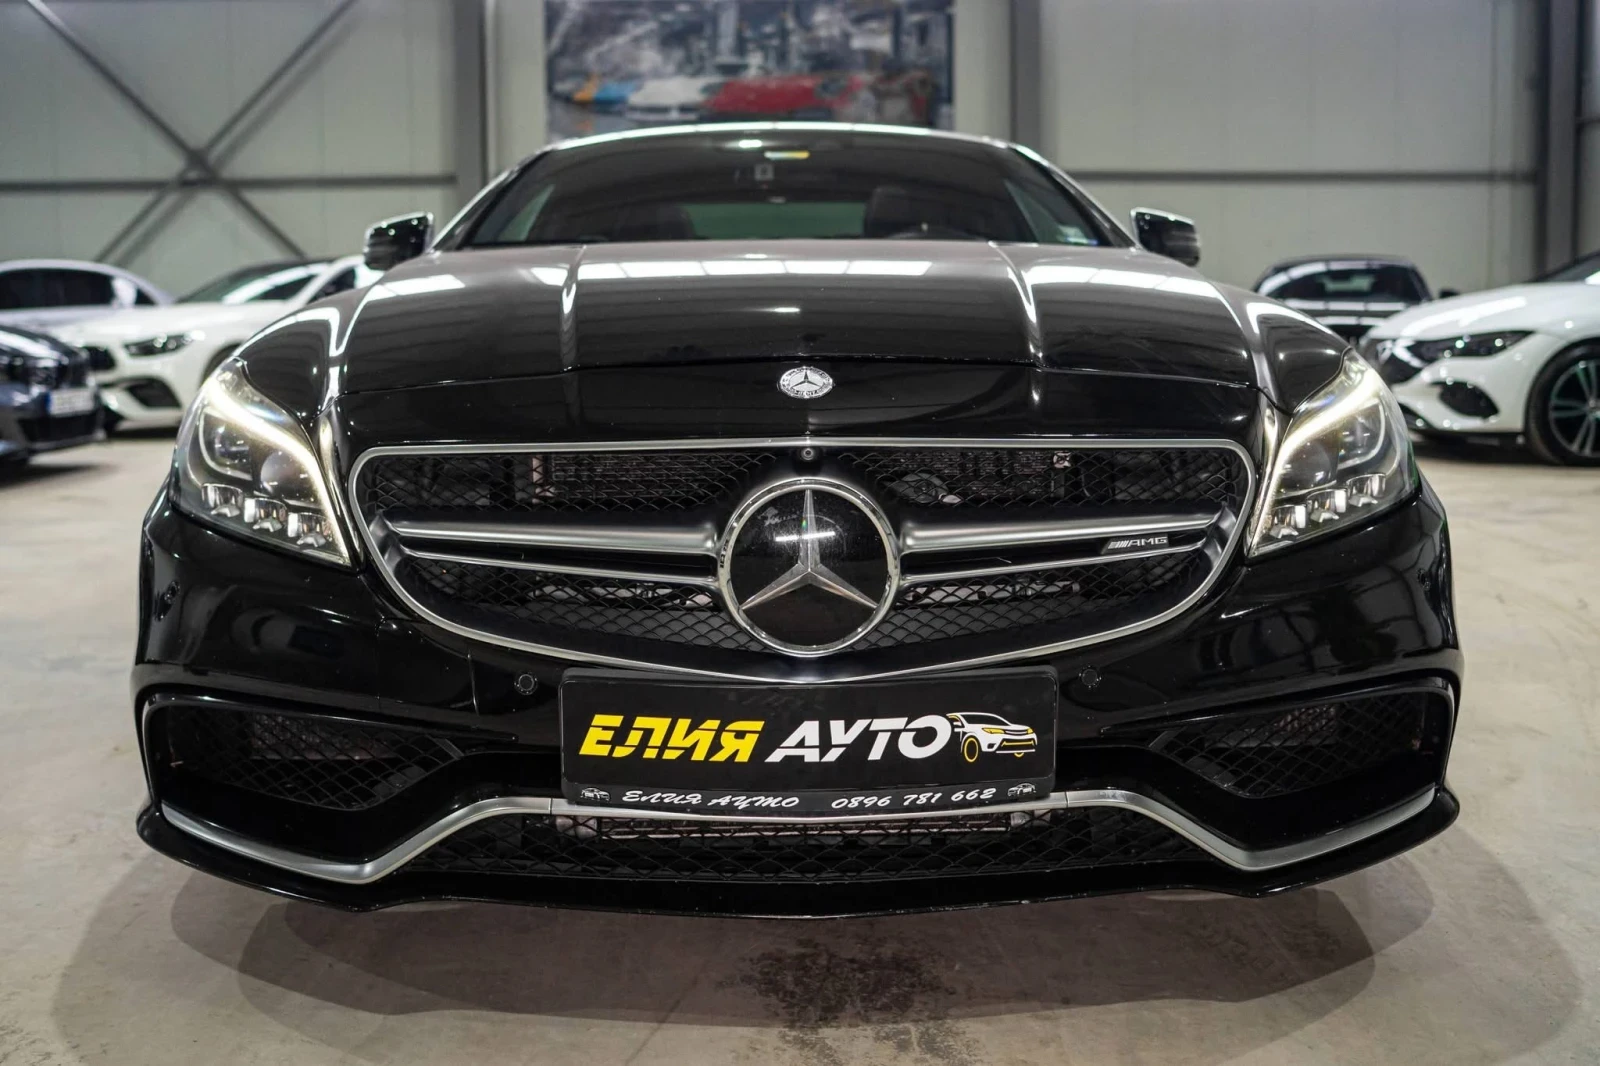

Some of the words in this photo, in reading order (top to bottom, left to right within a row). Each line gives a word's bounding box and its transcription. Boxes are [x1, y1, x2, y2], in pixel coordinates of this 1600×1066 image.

[1126, 536, 1168, 547] AMG
[579, 714, 765, 763] ЕЛИЯ
[765, 713, 952, 763] АУТО
[831, 795, 892, 809] 0896
[903, 792, 943, 806] 781
[951, 788, 997, 802] 662
